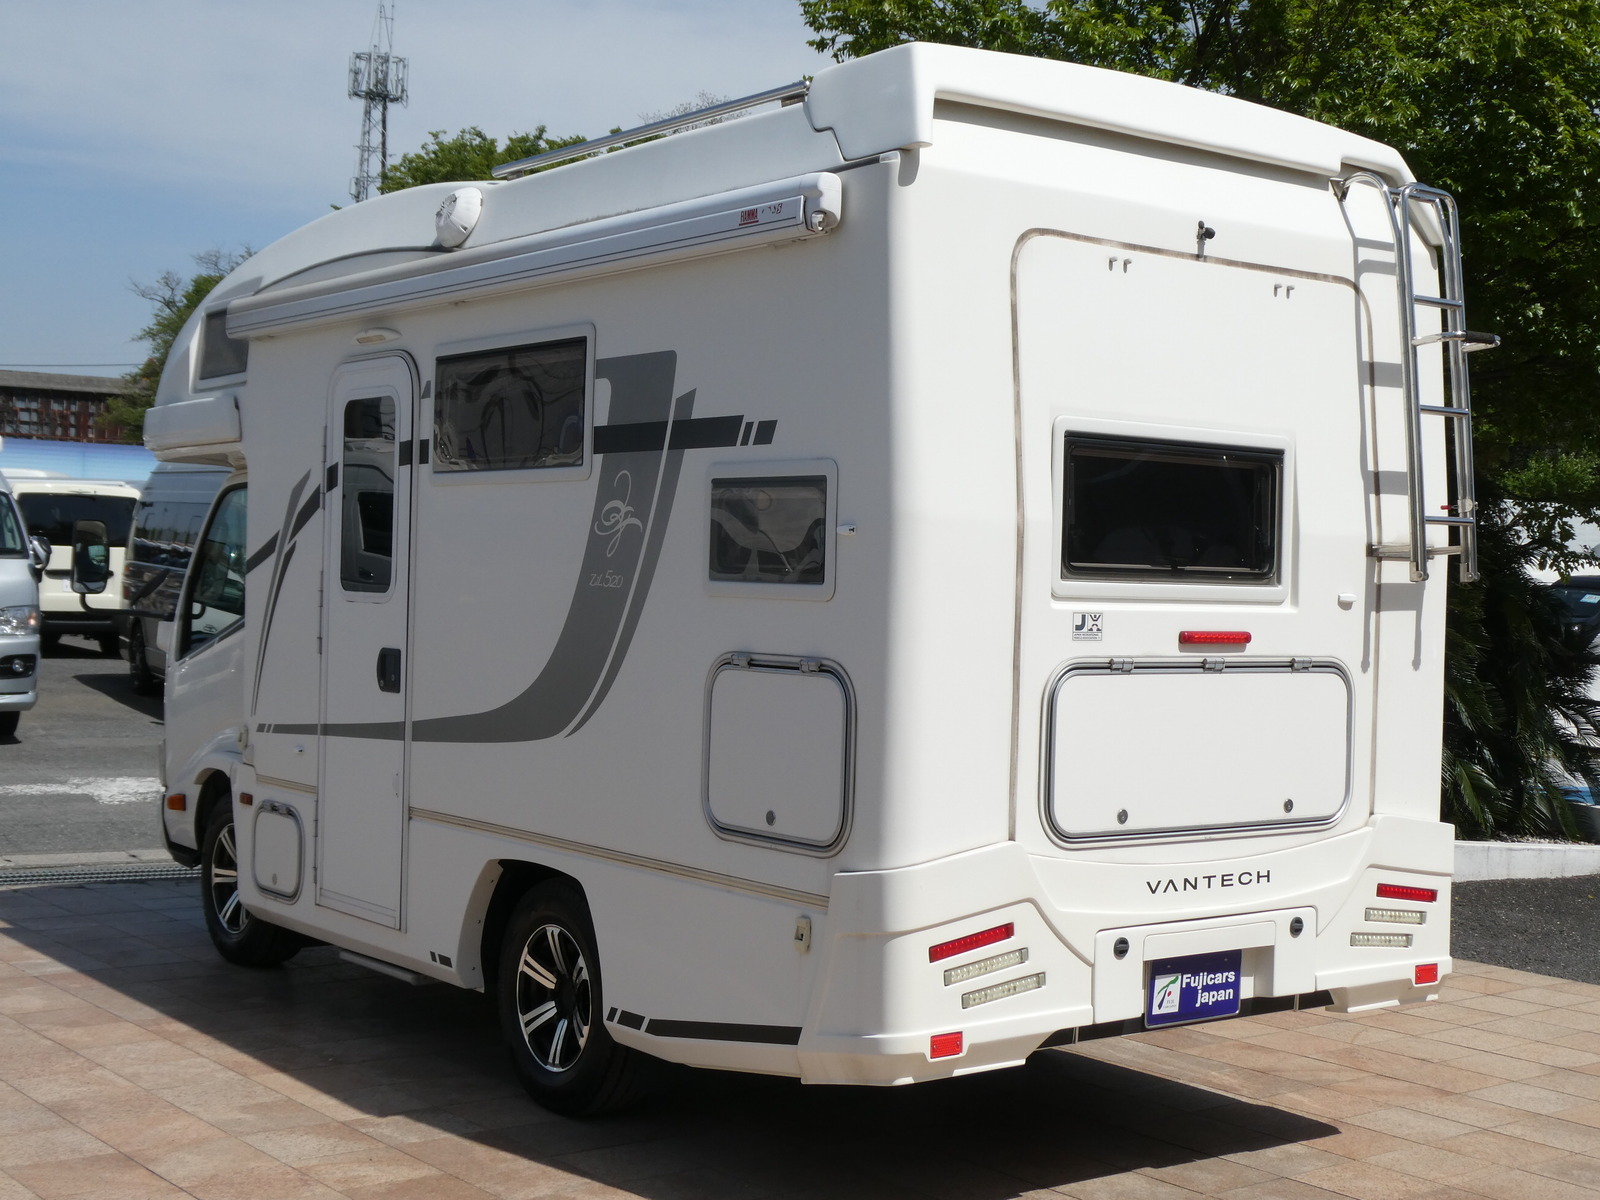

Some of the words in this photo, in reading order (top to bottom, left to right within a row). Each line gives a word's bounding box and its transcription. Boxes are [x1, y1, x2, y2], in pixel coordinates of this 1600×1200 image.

[1146, 869, 1270, 894] VANTECH
[1182, 971, 1235, 989] Fujicars
[1195, 988, 1234, 1007] japan
